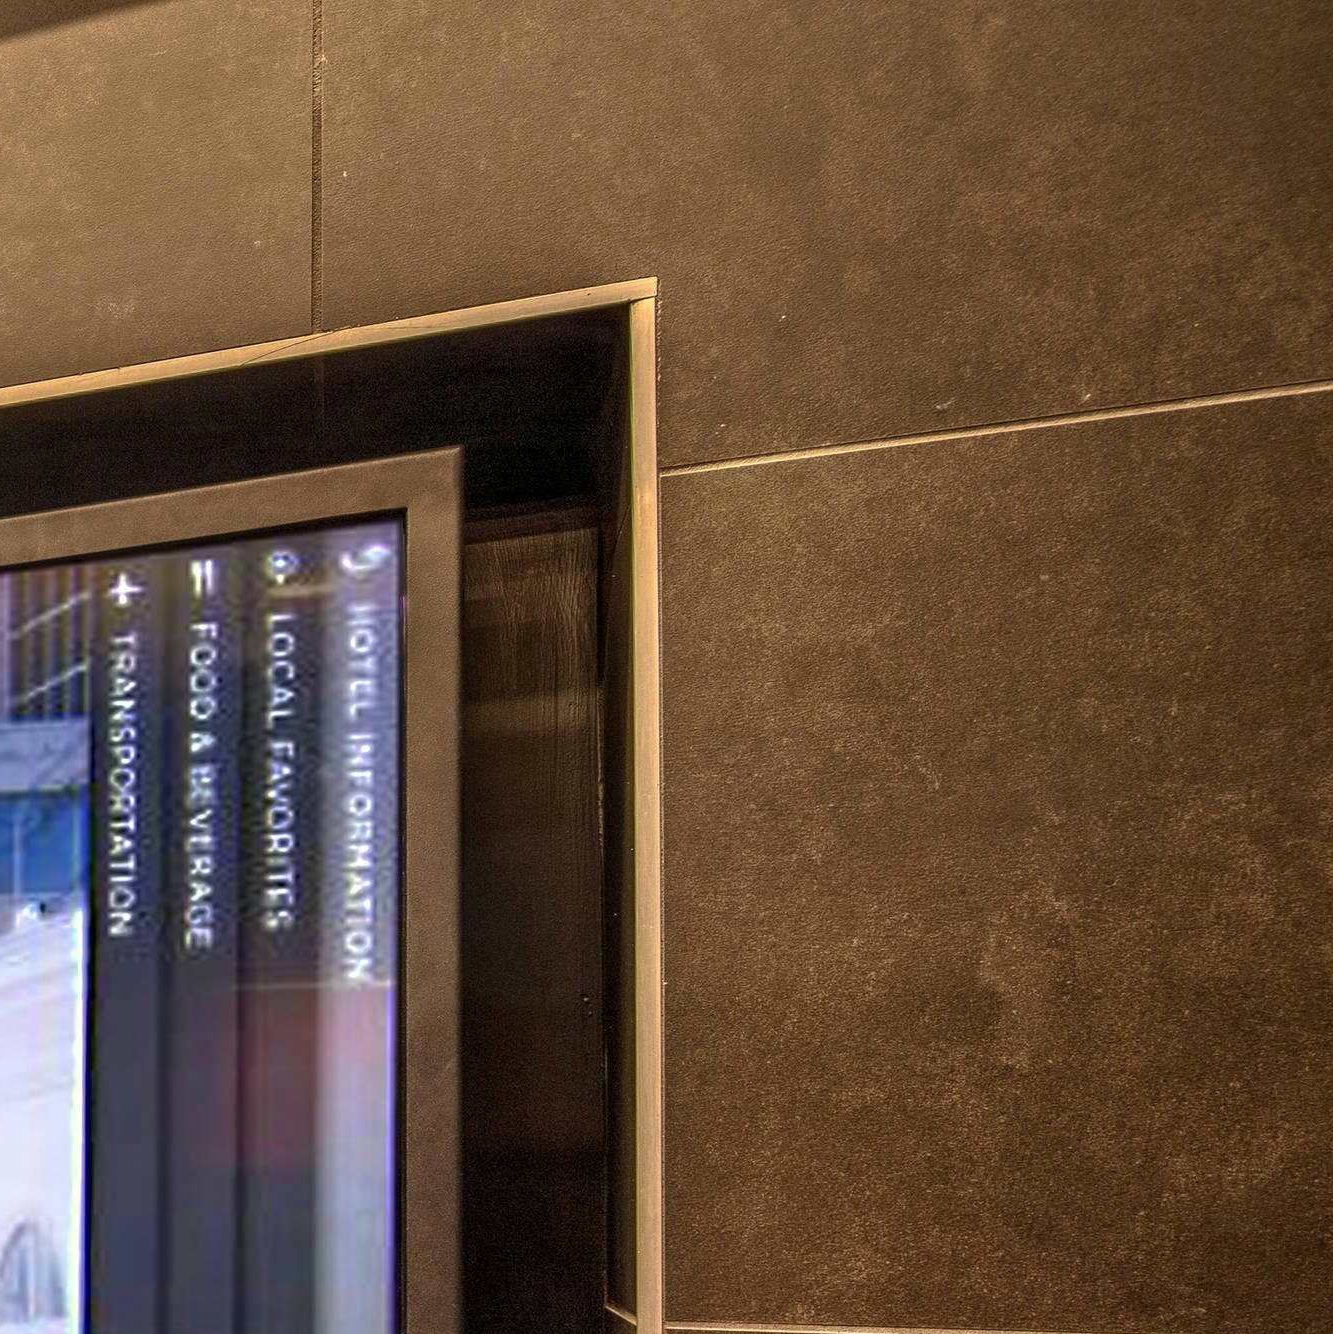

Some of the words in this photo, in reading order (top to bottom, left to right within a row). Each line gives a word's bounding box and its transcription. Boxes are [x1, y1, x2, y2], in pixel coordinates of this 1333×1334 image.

[189, 621, 218, 721] FOOD
[266, 613, 296, 730] LOCAL
[108, 634, 136, 936] TRANSPORTATION
[263, 739, 296, 933] FAVORITES
[344, 733, 376, 980] INFORMATION
